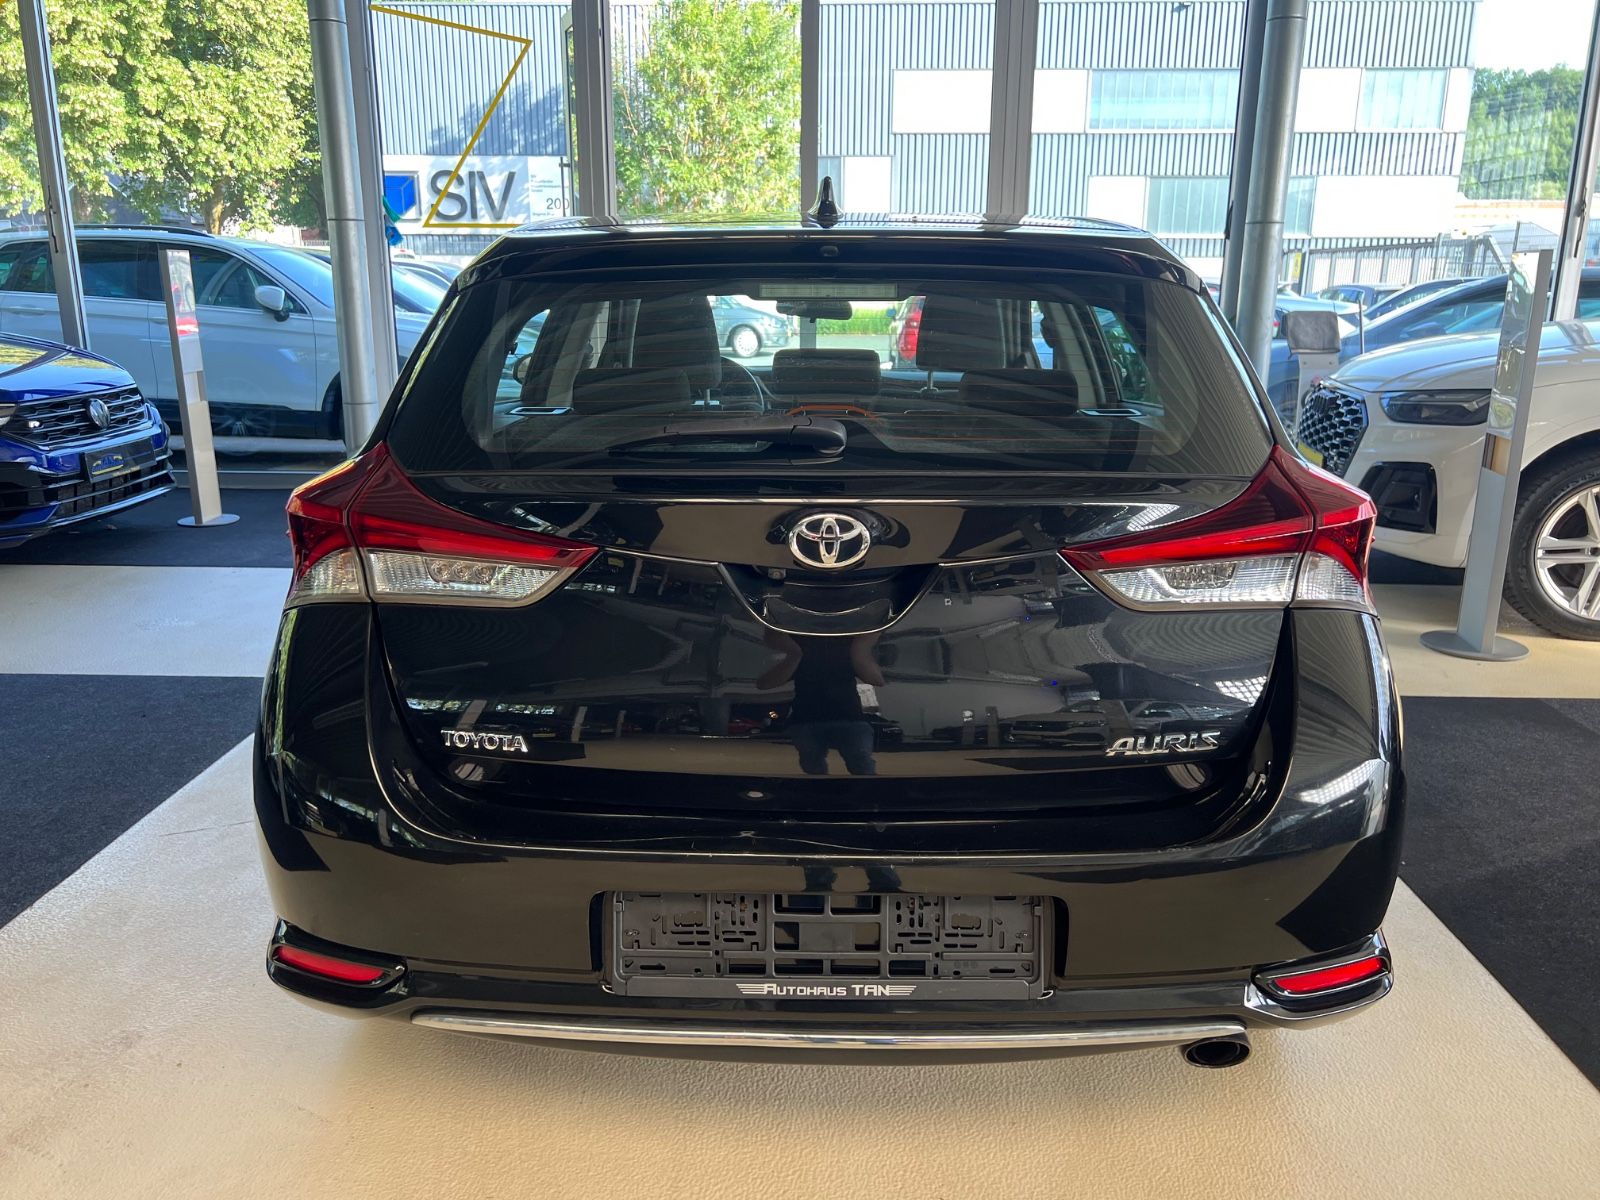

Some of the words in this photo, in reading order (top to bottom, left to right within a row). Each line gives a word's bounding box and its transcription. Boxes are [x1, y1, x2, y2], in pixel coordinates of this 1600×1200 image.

[430, 169, 517, 221] SIV
[440, 729, 529, 752] TOYOTA
[1105, 731, 1221, 757] AURIS
[763, 983, 847, 996] AUTOHAUS
[851, 984, 890, 997] TAN
